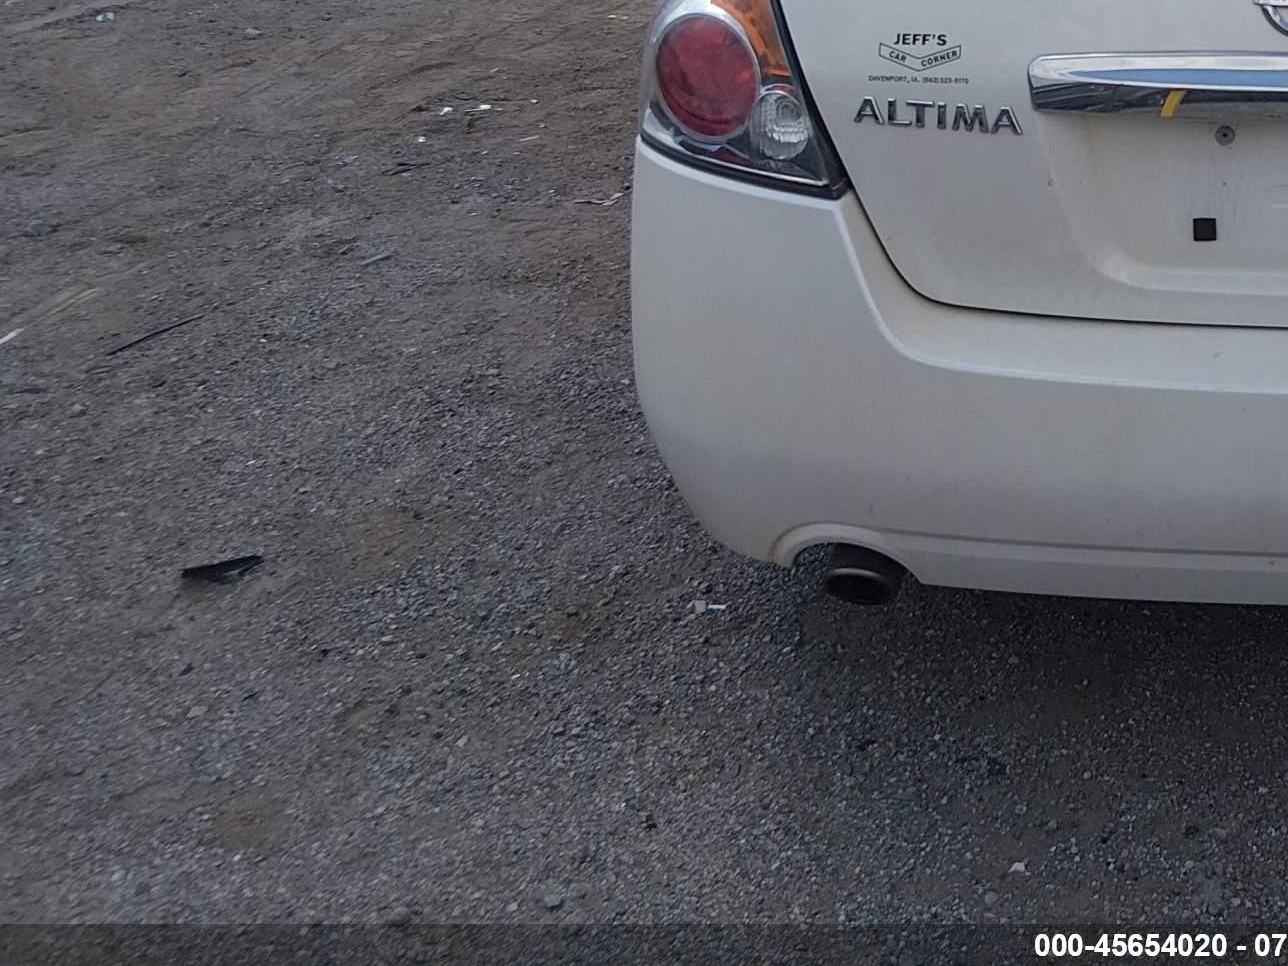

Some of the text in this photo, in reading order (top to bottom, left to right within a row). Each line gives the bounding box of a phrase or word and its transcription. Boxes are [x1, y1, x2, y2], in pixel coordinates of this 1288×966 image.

[893, 33, 948, 47] JEFF'S
[889, 50, 958, 68] CAR CORNER
[854, 95, 1023, 136] ALTIMA
